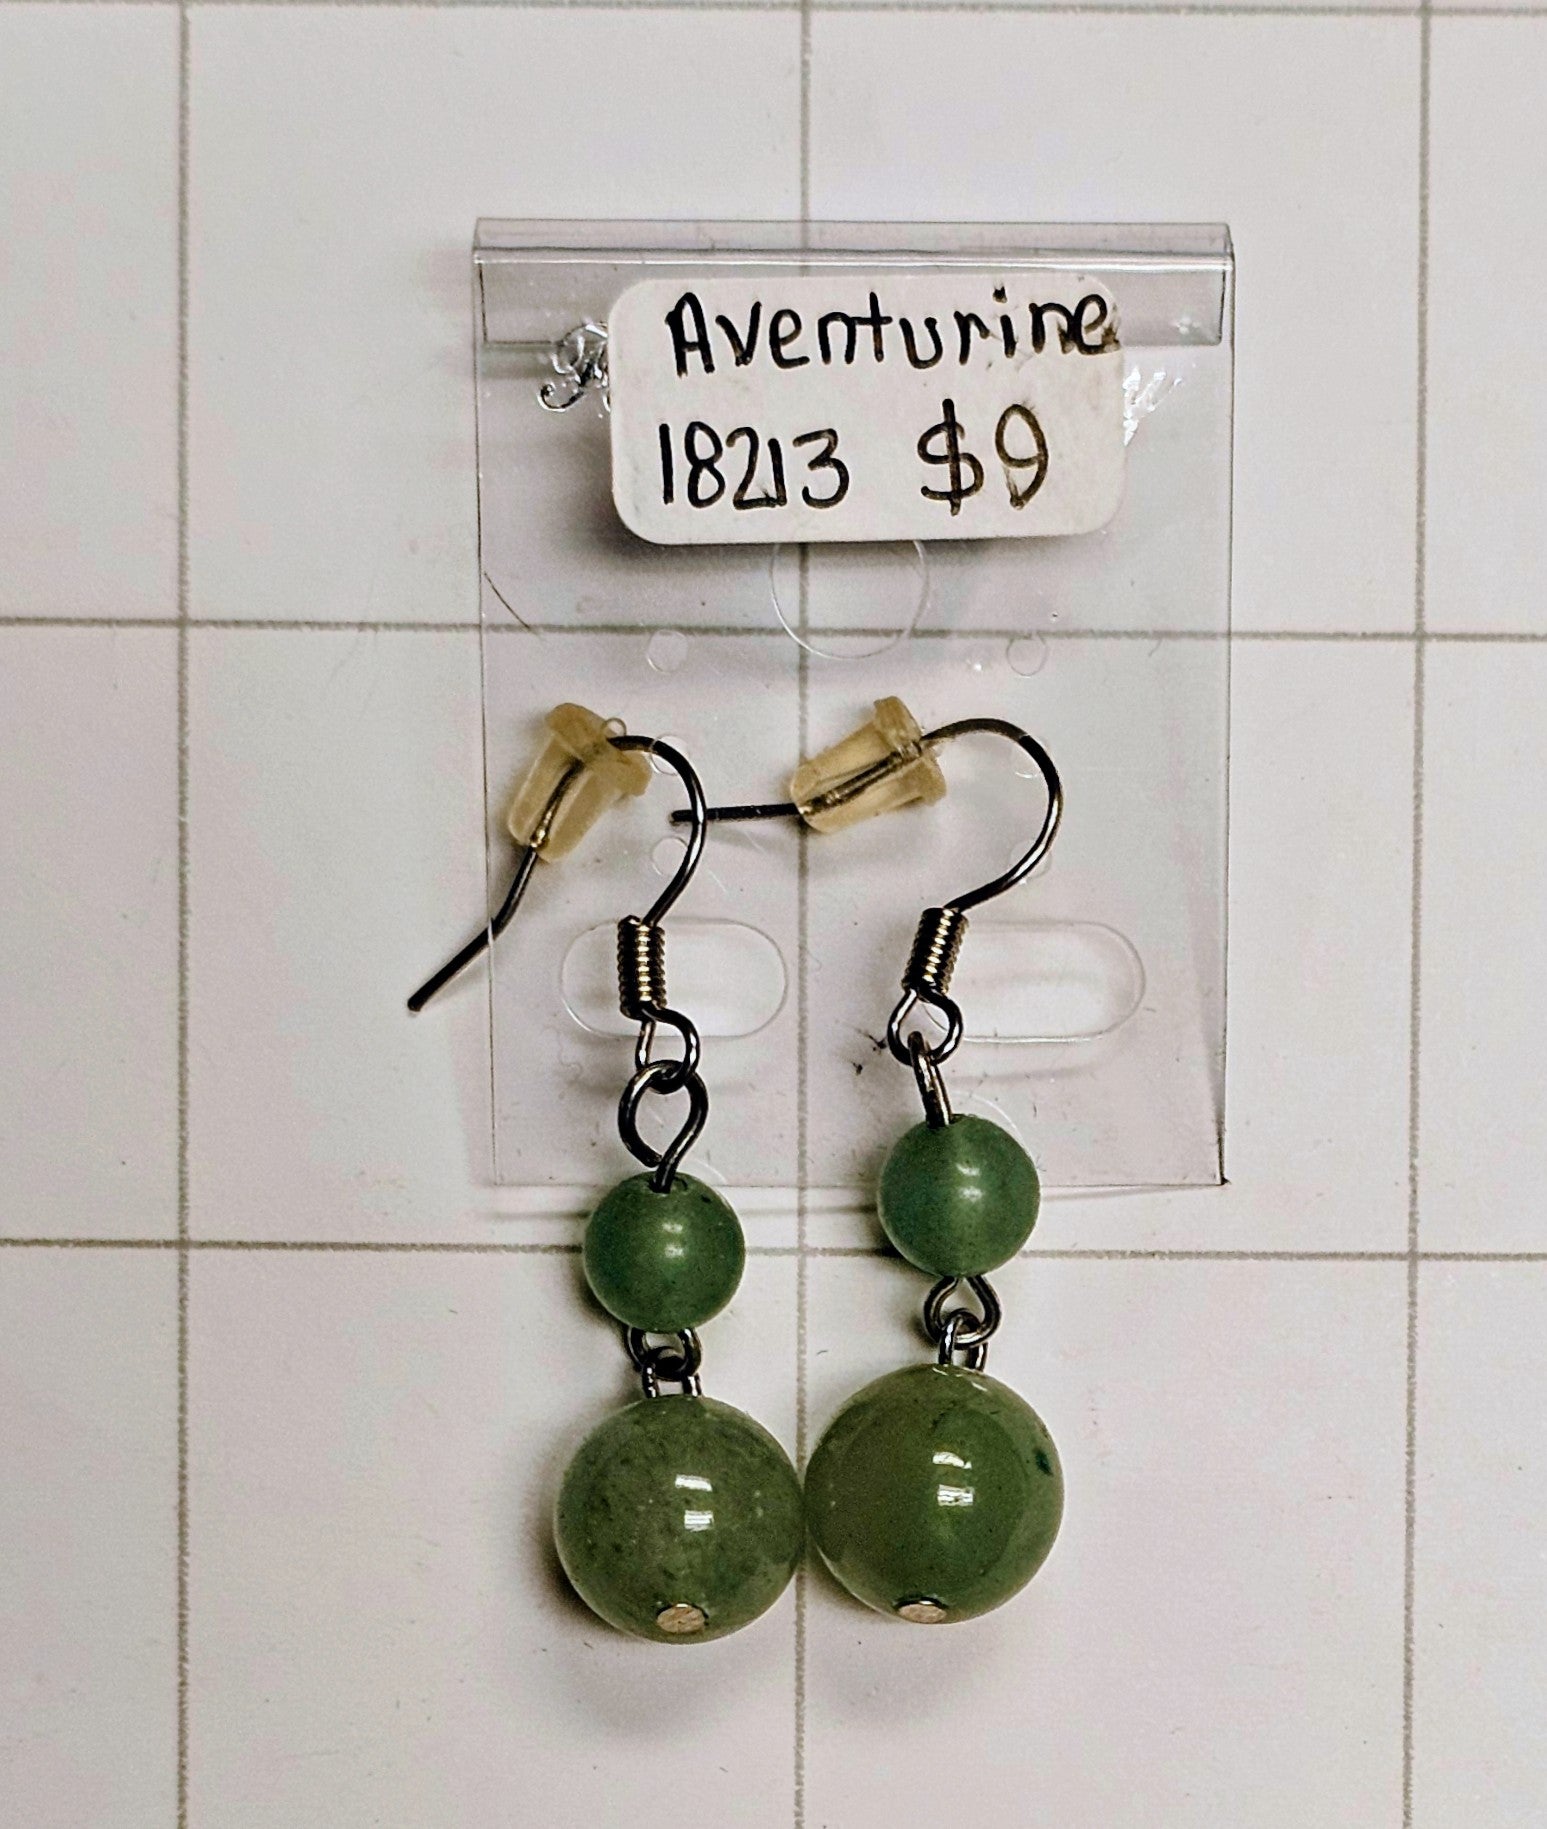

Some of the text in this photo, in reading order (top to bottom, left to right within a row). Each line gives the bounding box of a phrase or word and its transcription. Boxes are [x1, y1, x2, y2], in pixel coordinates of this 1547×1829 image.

[665, 287, 1119, 378] Aventurine
[658, 398, 1049, 517] 18213 $9
